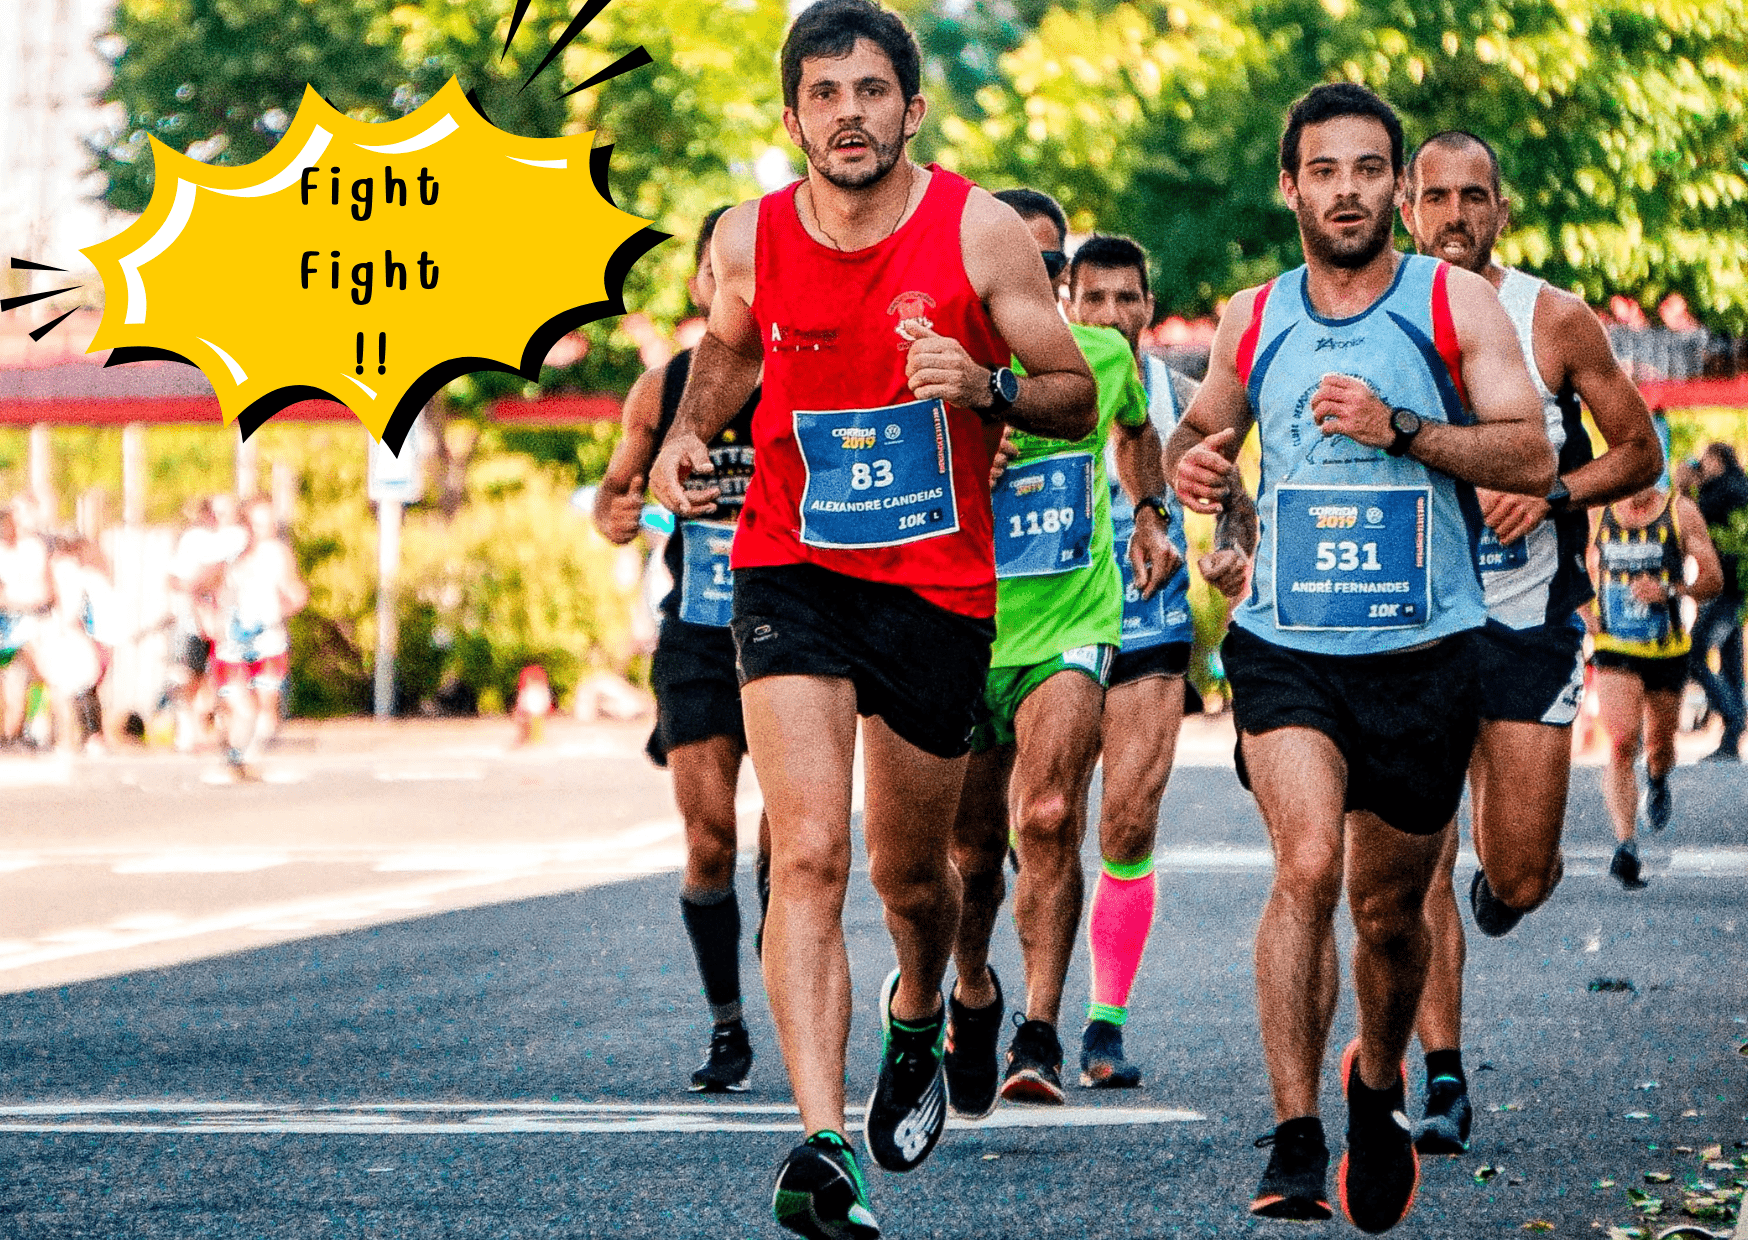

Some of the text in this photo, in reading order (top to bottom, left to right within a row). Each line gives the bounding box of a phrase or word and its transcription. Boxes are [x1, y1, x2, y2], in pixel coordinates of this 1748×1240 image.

[831, 427, 877, 438] CORRIDA
[841, 436, 876, 450] 2019
[851, 459, 894, 491] 83
[811, 487, 943, 513] ALEXANDRE CANDEIAS
[898, 512, 926, 530] 10K
[1009, 507, 1074, 538] 1189
[1316, 514, 1357, 529] 2019
[1315, 541, 1382, 571] 531
[1291, 579, 1410, 593] ANDRÉ FERNANDES
[1368, 603, 1400, 618] 10K
